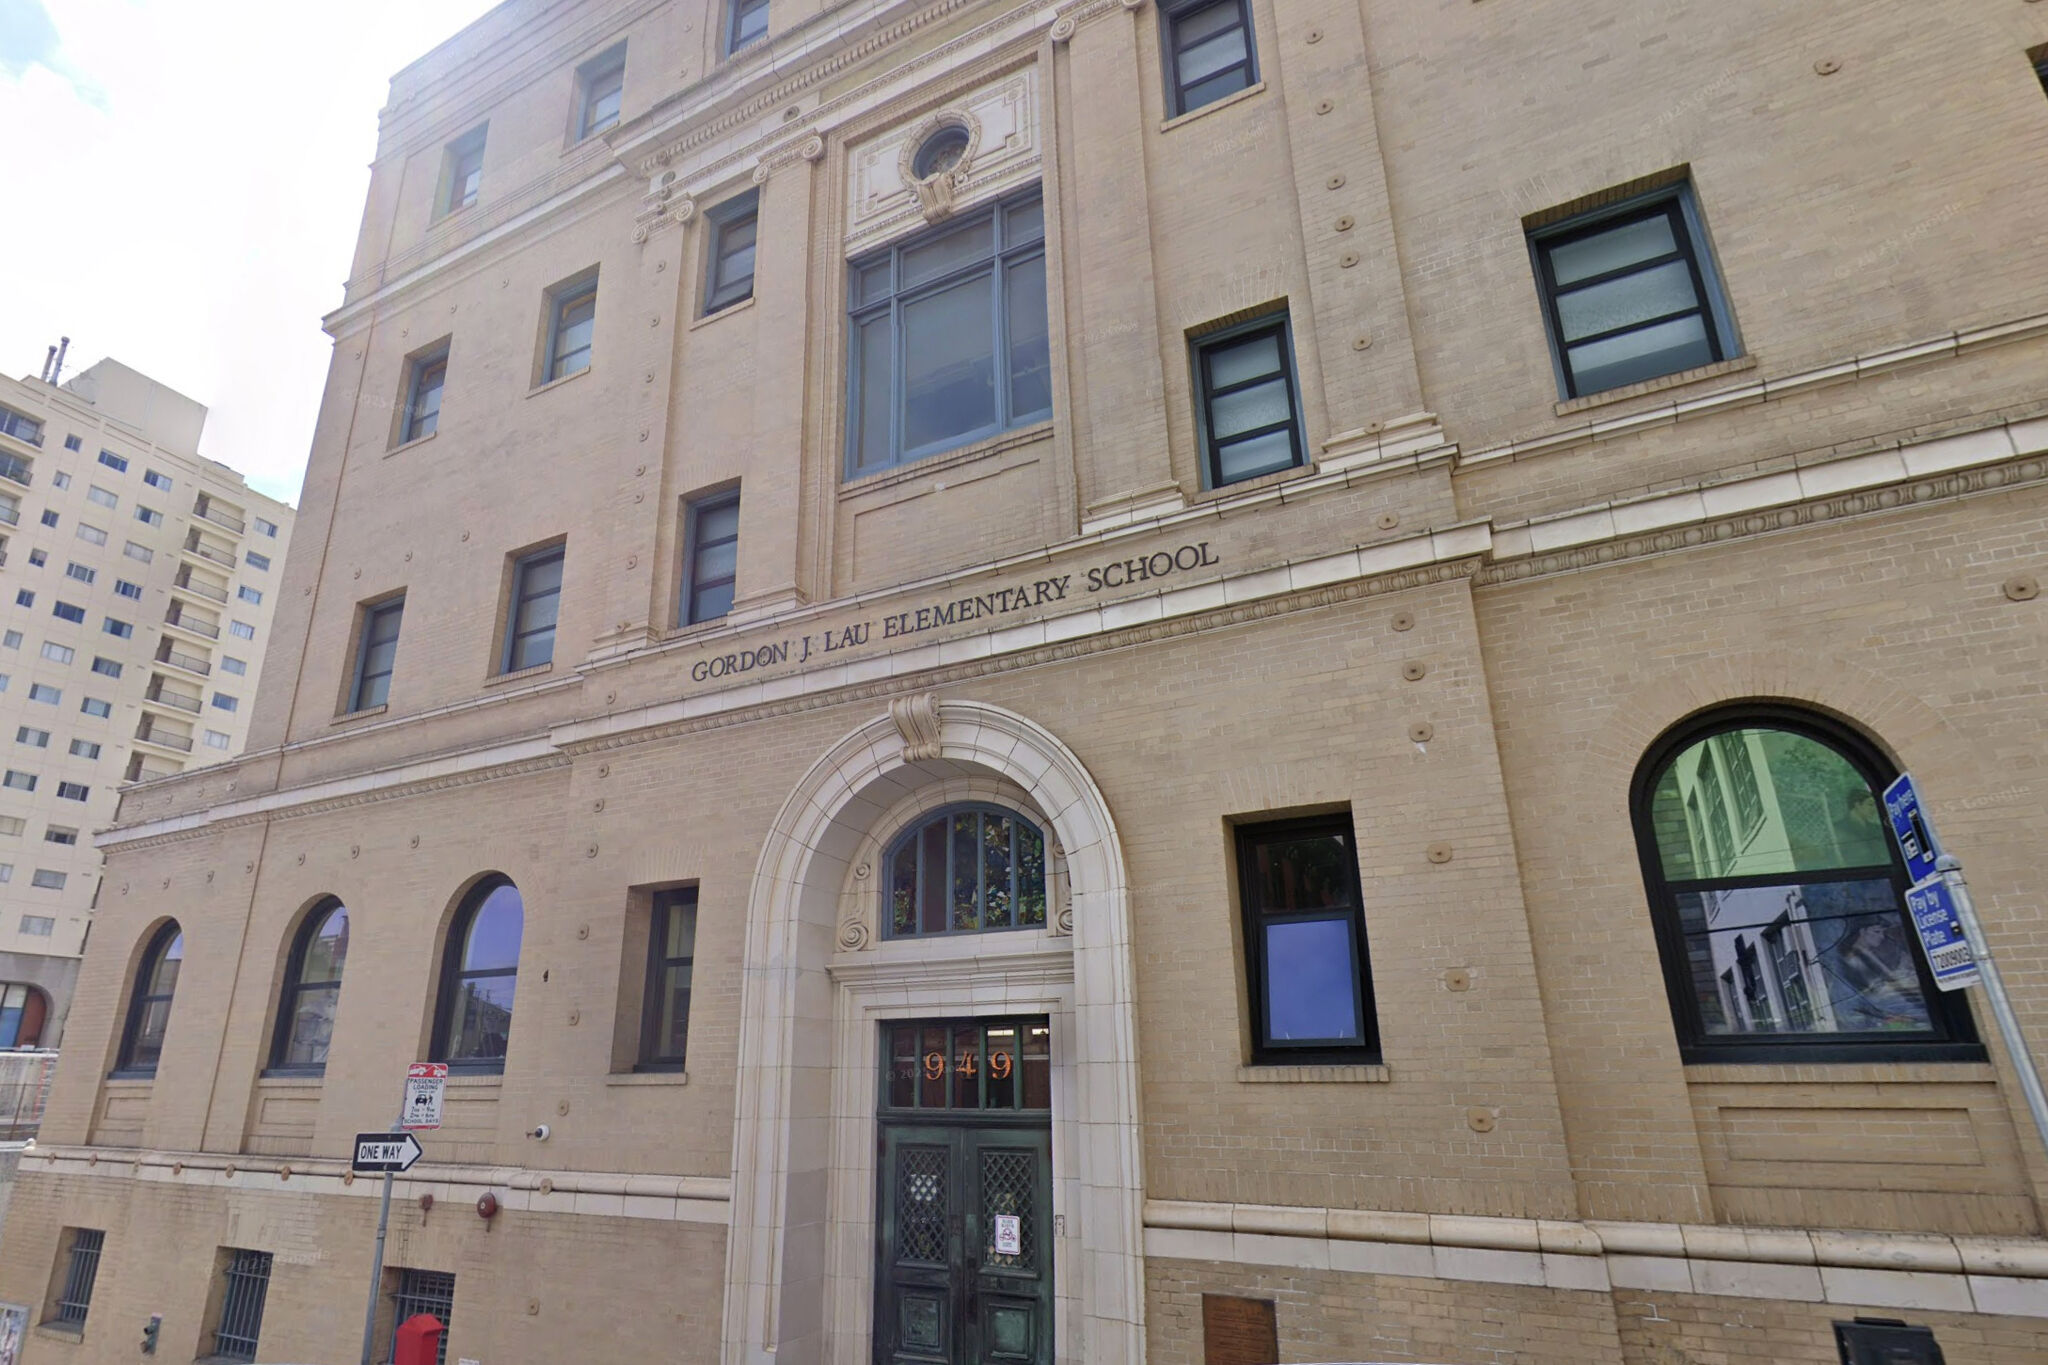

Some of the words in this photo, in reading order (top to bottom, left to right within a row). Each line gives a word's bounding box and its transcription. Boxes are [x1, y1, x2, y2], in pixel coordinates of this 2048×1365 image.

[691, 641, 789, 683] GORDON
[799, 636, 814, 663] J.
[824, 623, 870, 652] LAU
[883, 575, 1071, 638] ELEMENTARY
[1087, 542, 1219, 593] SCHOOL
[1909, 894, 1928, 913] Pay
[1924, 889, 1940, 909] by
[1915, 908, 1950, 930] License
[1922, 929, 1948, 948] Plate
[925, 1050, 1012, 1081] 949
[360, 1145, 379, 1160] ONE
[382, 1145, 402, 1159] WAY
